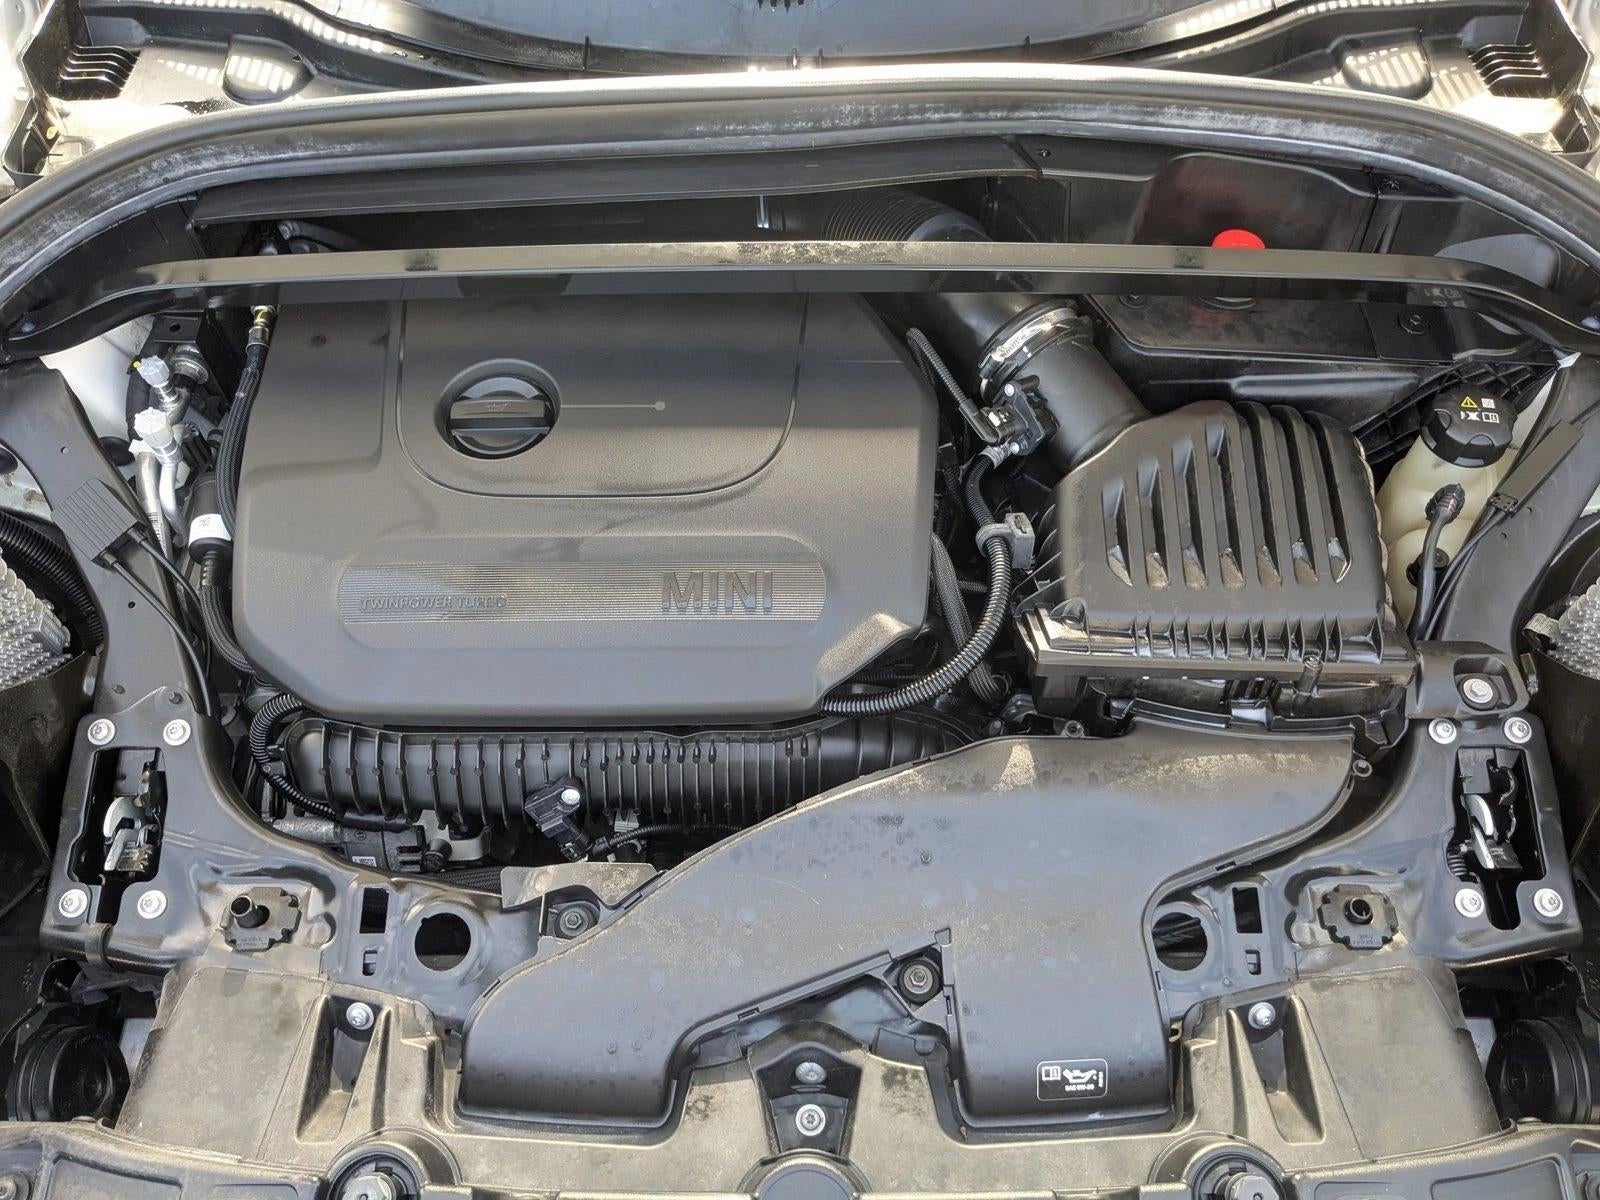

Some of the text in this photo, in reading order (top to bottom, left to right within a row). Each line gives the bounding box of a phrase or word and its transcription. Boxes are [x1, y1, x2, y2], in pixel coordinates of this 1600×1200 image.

[361, 593, 509, 612] TWINPOWER TURBO
[661, 571, 772, 612] MINI
